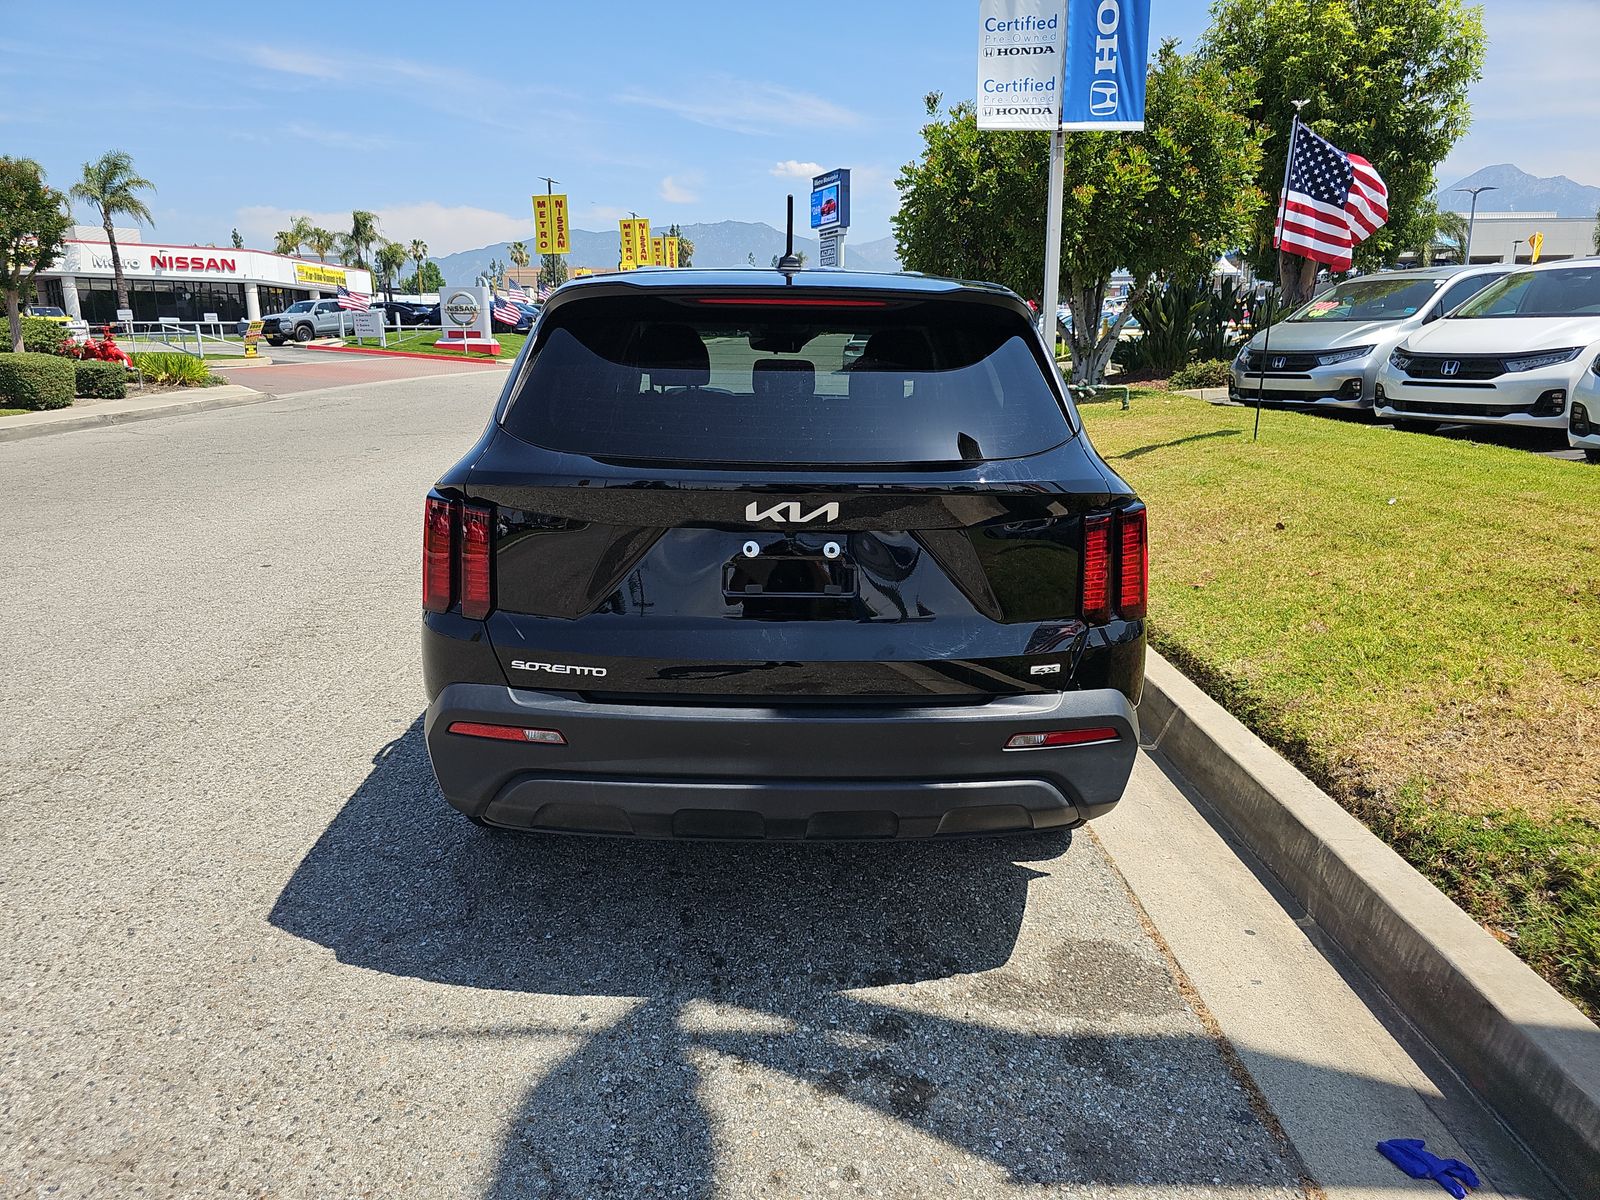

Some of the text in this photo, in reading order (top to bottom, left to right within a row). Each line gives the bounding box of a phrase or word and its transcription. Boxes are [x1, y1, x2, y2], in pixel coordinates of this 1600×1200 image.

[985, 14, 1057, 32] Certified
[985, 33, 1056, 43] Pre-Owned
[1095, 0, 1119, 74] HO
[997, 45, 1055, 56] HONDA
[983, 76, 1055, 93] Certified
[984, 95, 1054, 104] Pre-Owned
[996, 107, 1053, 117] HONDA
[536, 200, 548, 248] METRO
[554, 199, 565, 248] NISSAN
[623, 223, 633, 261] METRO
[638, 223, 648, 261] NISSAN
[92, 255, 236, 272] Mero NISSAN
[745, 501, 839, 523] KIA
[511, 660, 607, 677] SORENTO
